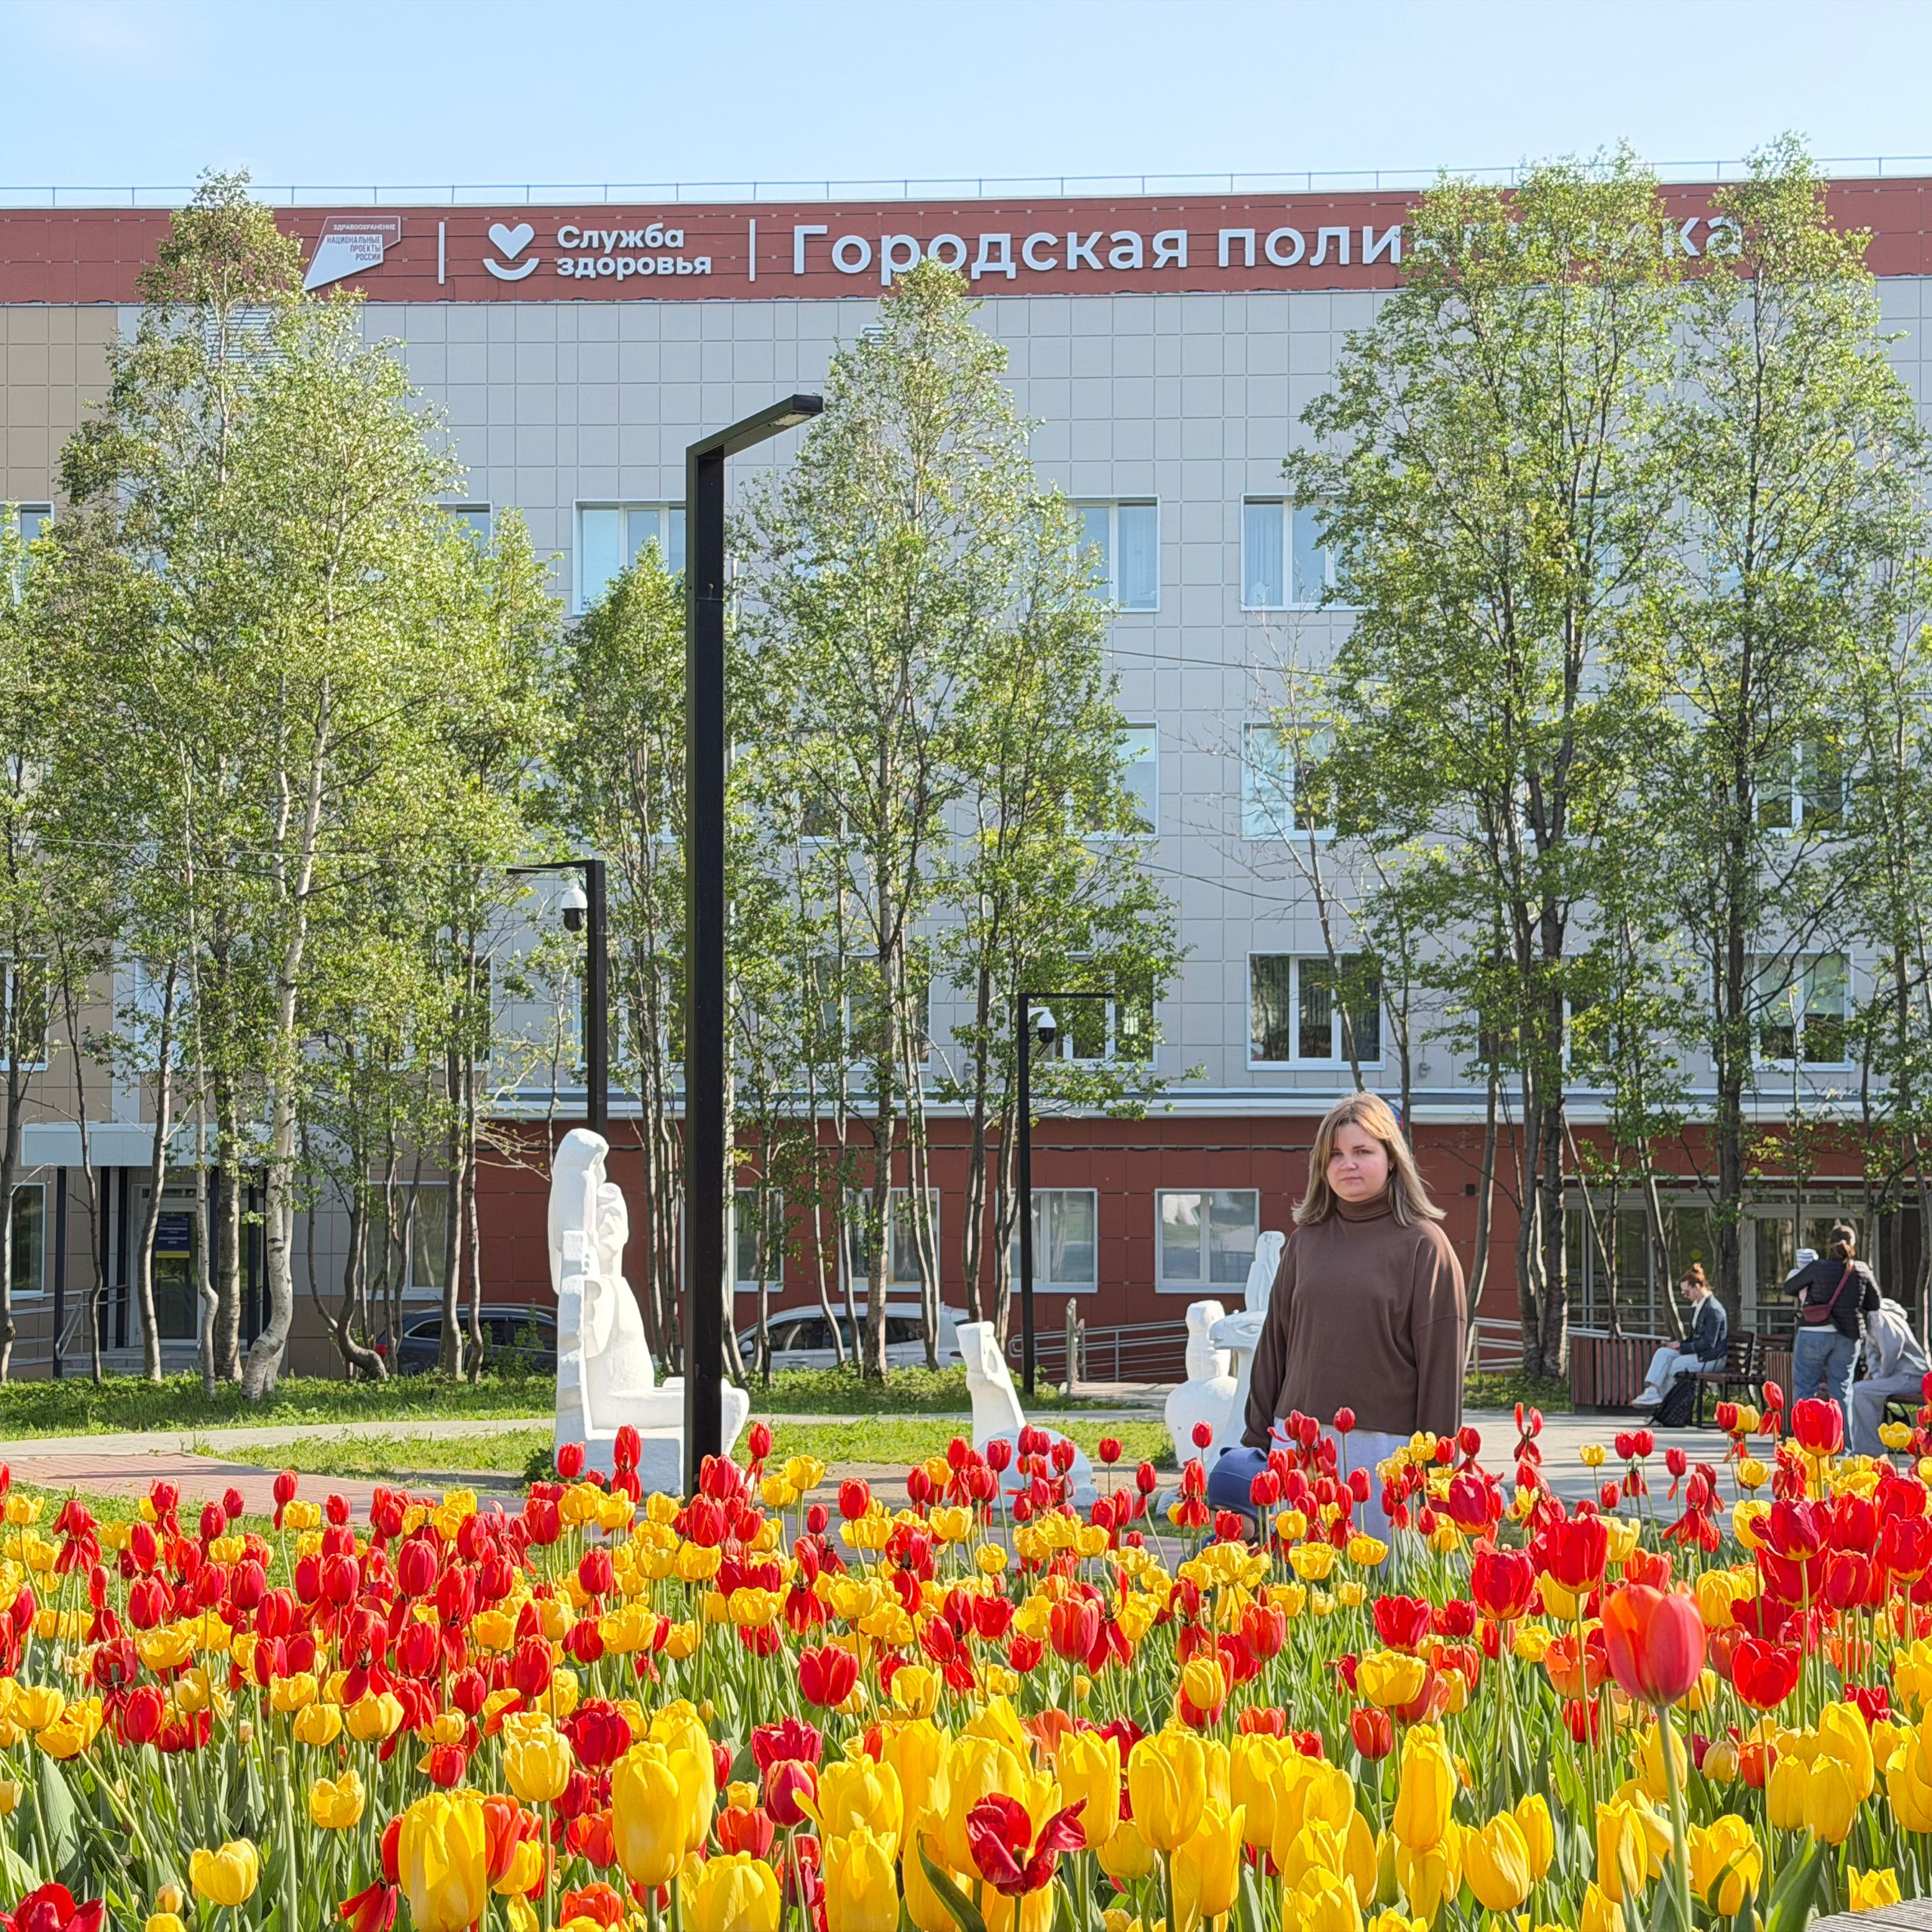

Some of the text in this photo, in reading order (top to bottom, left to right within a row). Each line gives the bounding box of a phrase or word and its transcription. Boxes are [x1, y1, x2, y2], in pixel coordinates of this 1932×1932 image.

[326, 235, 381, 245] НАЦИОНАЛЬНЫЕ
[557, 223, 685, 254] Служба
[349, 245, 381, 253] ПРОЕКТЫ
[355, 253, 381, 261] РОССИИ
[794, 217, 1743, 286] Городская полика
[556, 256, 712, 281] здоровья
